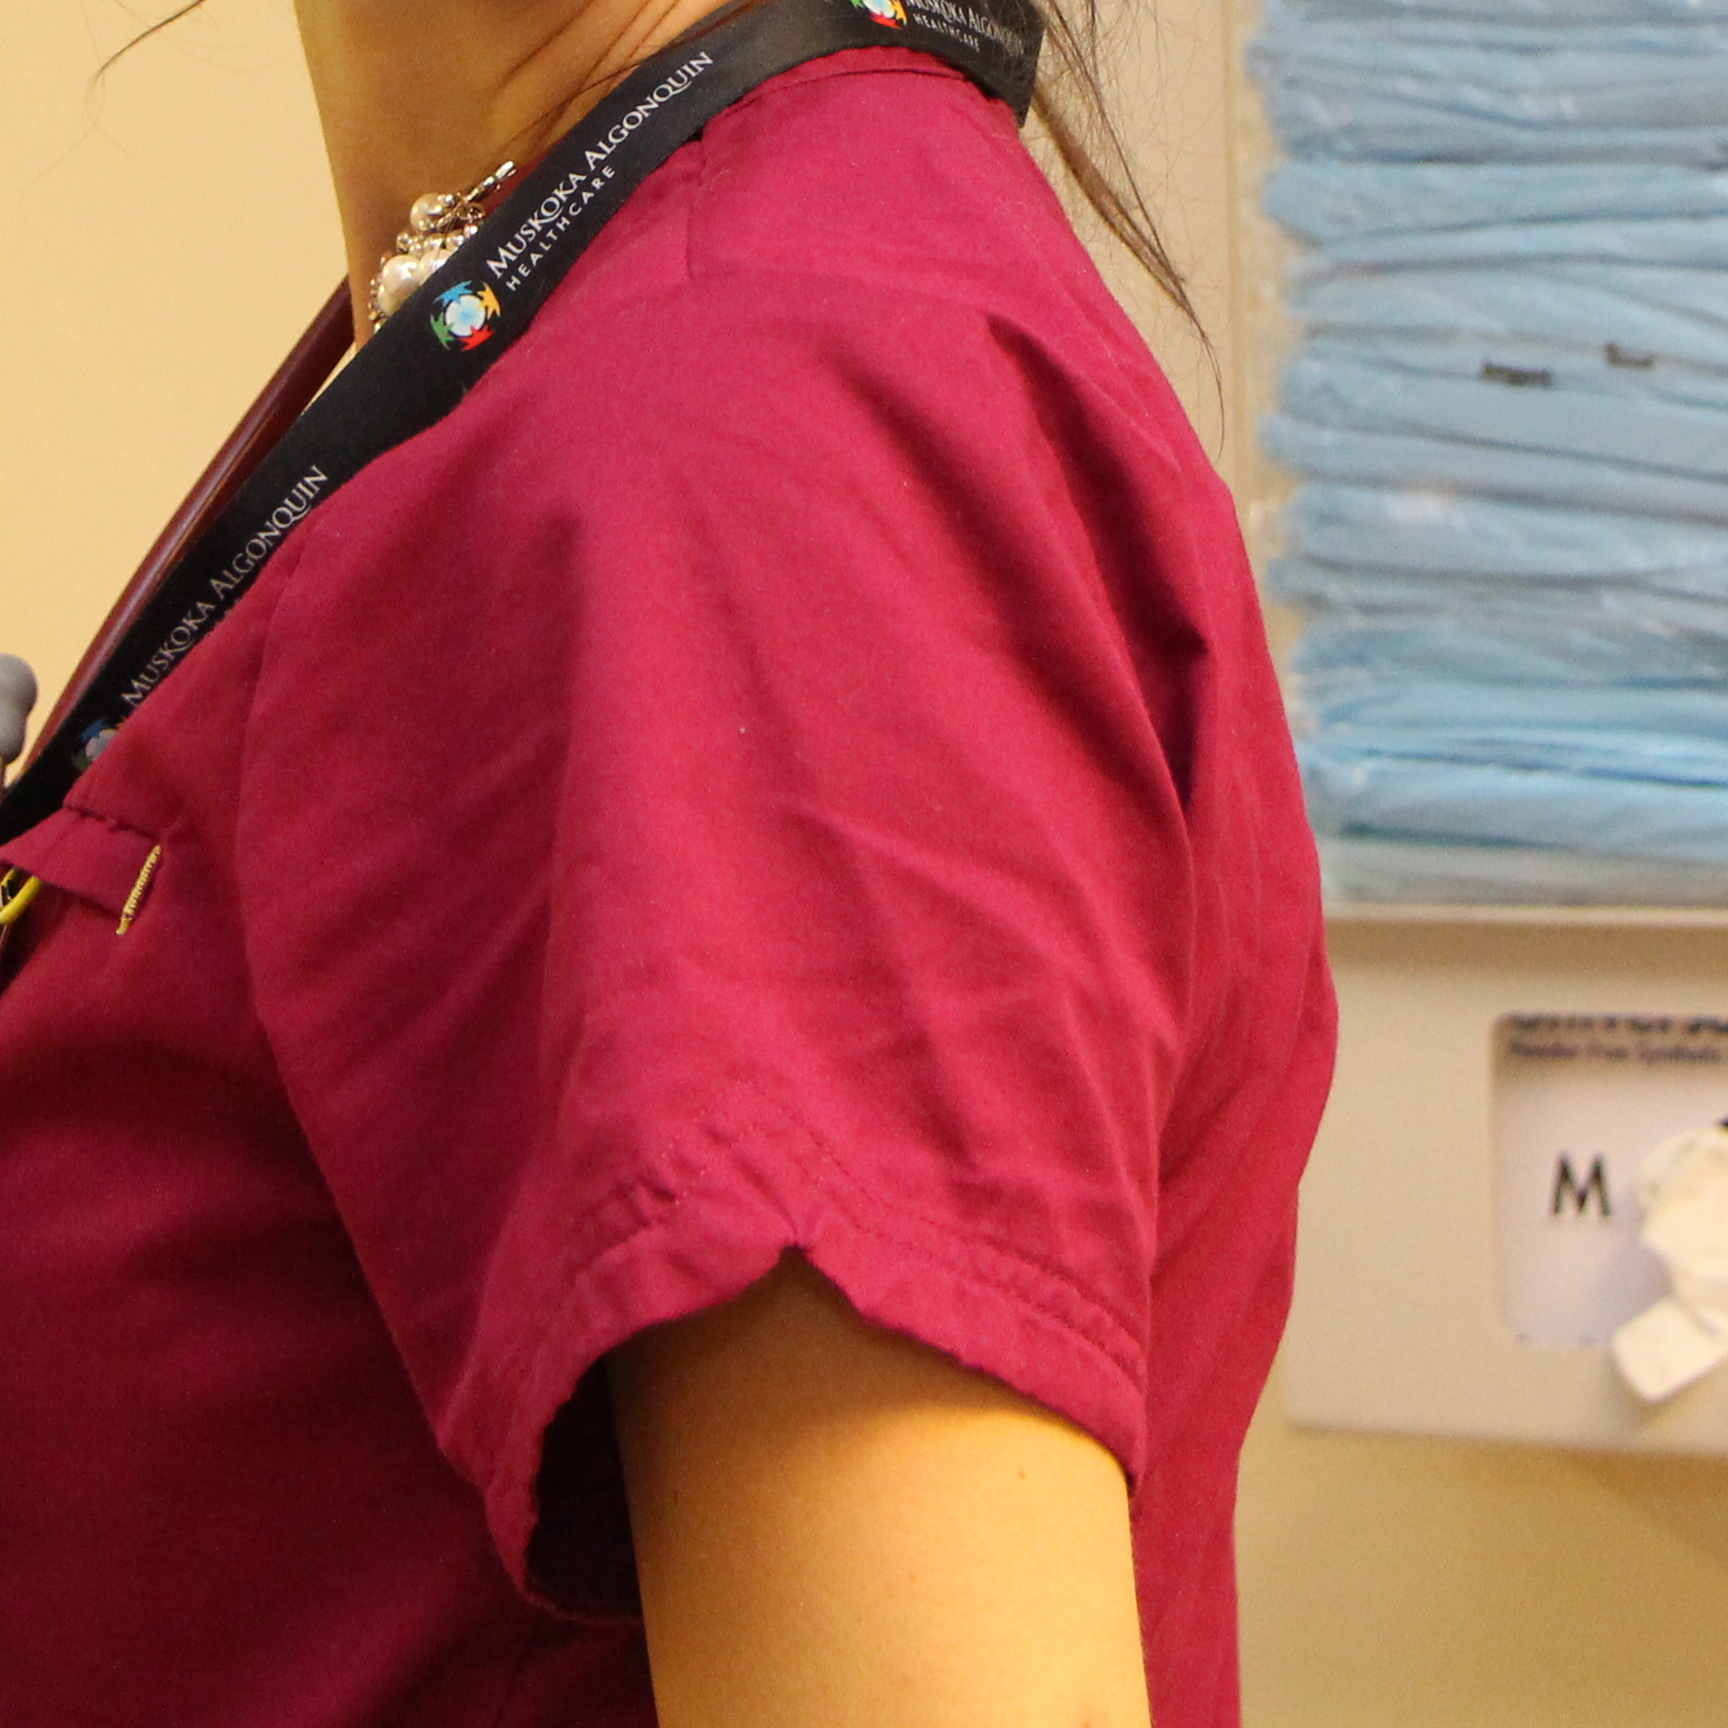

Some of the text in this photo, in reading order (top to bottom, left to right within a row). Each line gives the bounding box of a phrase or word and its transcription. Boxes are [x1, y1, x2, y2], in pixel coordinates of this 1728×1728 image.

[912, 13, 980, 52] HEALTHCARE
[487, 51, 713, 278] MUSKOKA ALGONQUIN
[506, 165, 615, 291] HEALTHCARE
[122, 465, 328, 706] MUSKOKA ALGONQUIN
[1548, 1151, 1614, 1220] M
